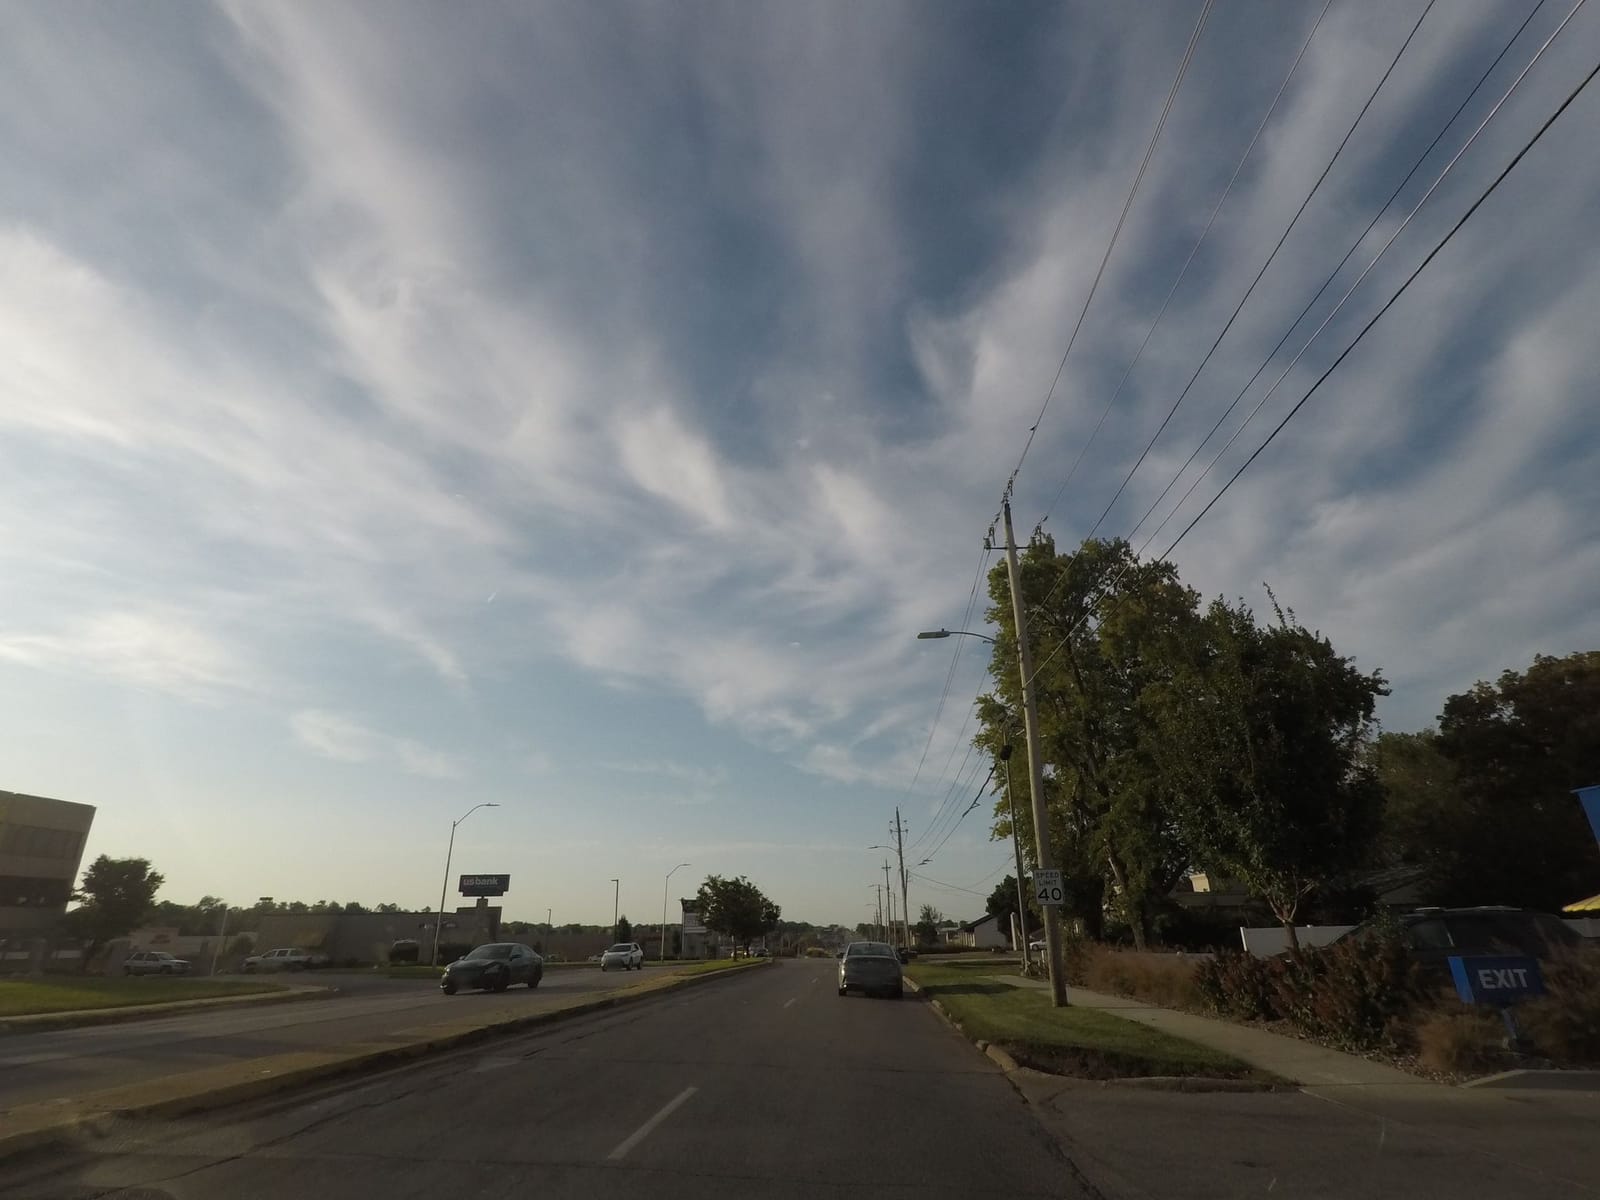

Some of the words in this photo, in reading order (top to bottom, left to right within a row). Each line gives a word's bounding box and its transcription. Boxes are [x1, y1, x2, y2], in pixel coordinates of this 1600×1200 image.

[1035, 871, 1059, 879] SPEED
[1038, 879, 1057, 887] LIMIT
[1037, 887, 1062, 901] 40
[1477, 968, 1528, 989] EXIT
